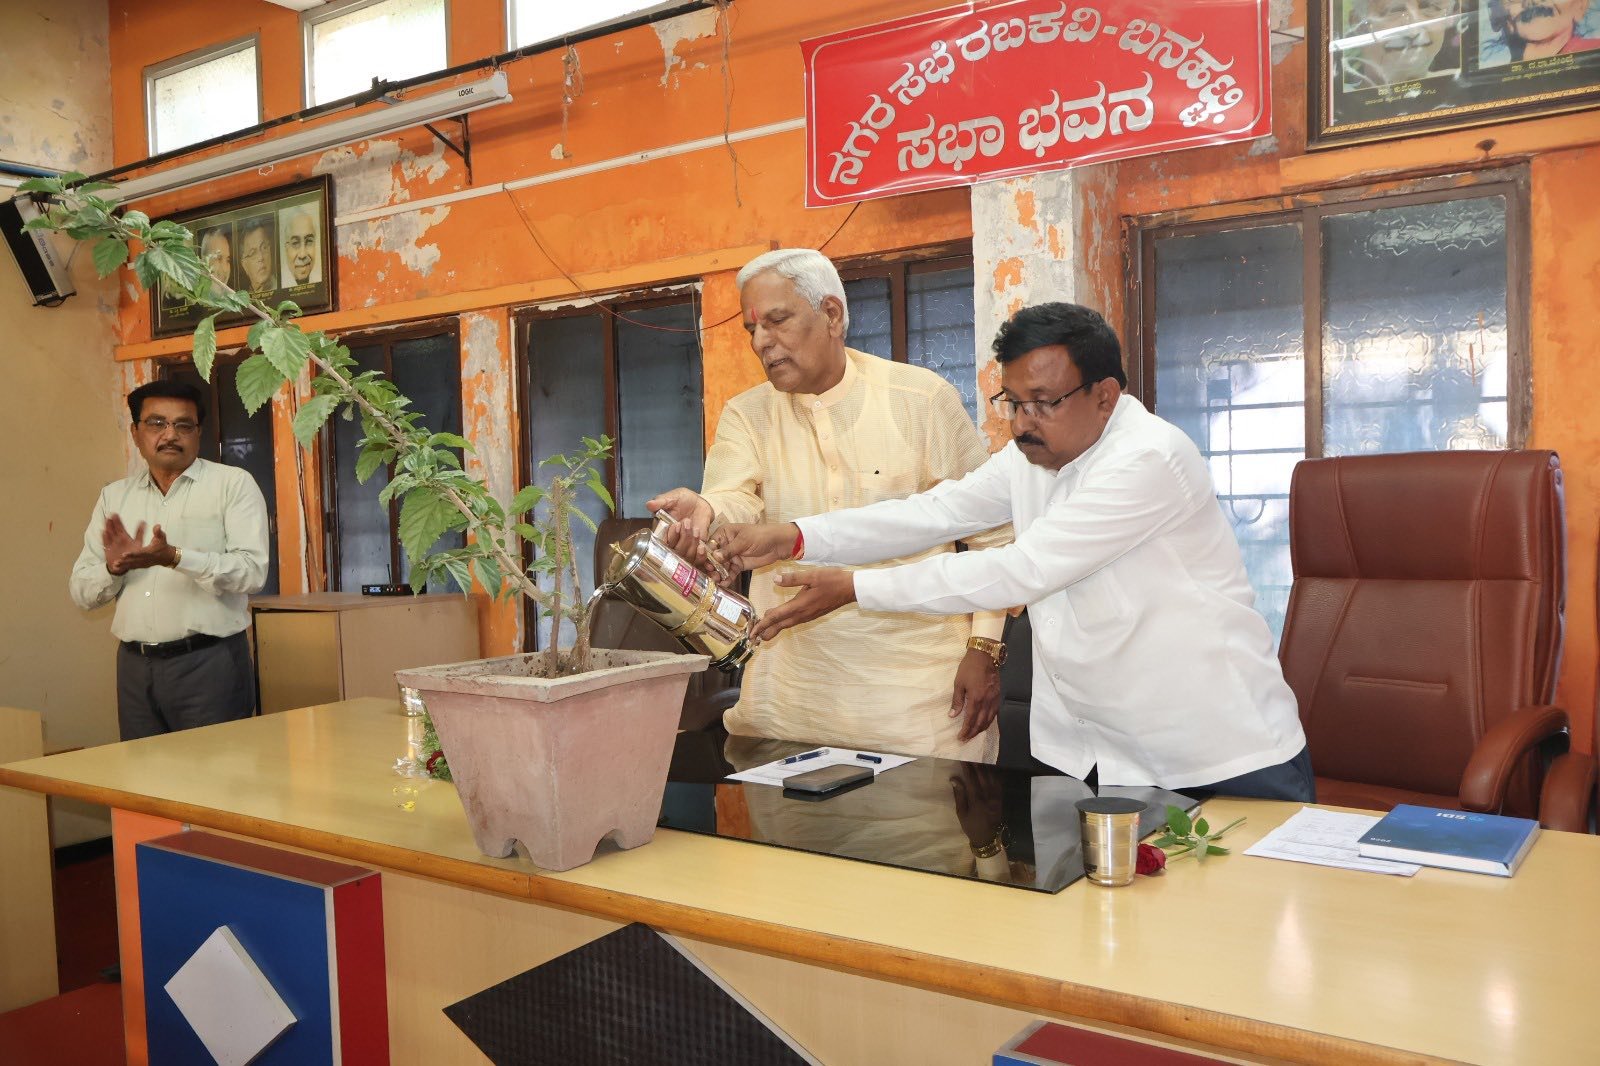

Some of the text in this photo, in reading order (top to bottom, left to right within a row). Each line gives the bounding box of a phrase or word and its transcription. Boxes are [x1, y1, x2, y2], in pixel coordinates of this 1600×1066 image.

[458, 87, 474, 97] LOGIC
[827, 94, 896, 185] ನಗರ
[888, 40, 956, 106] ಸಭೆ
[897, 71, 1154, 172] ಸಭಾ ಭವನ
